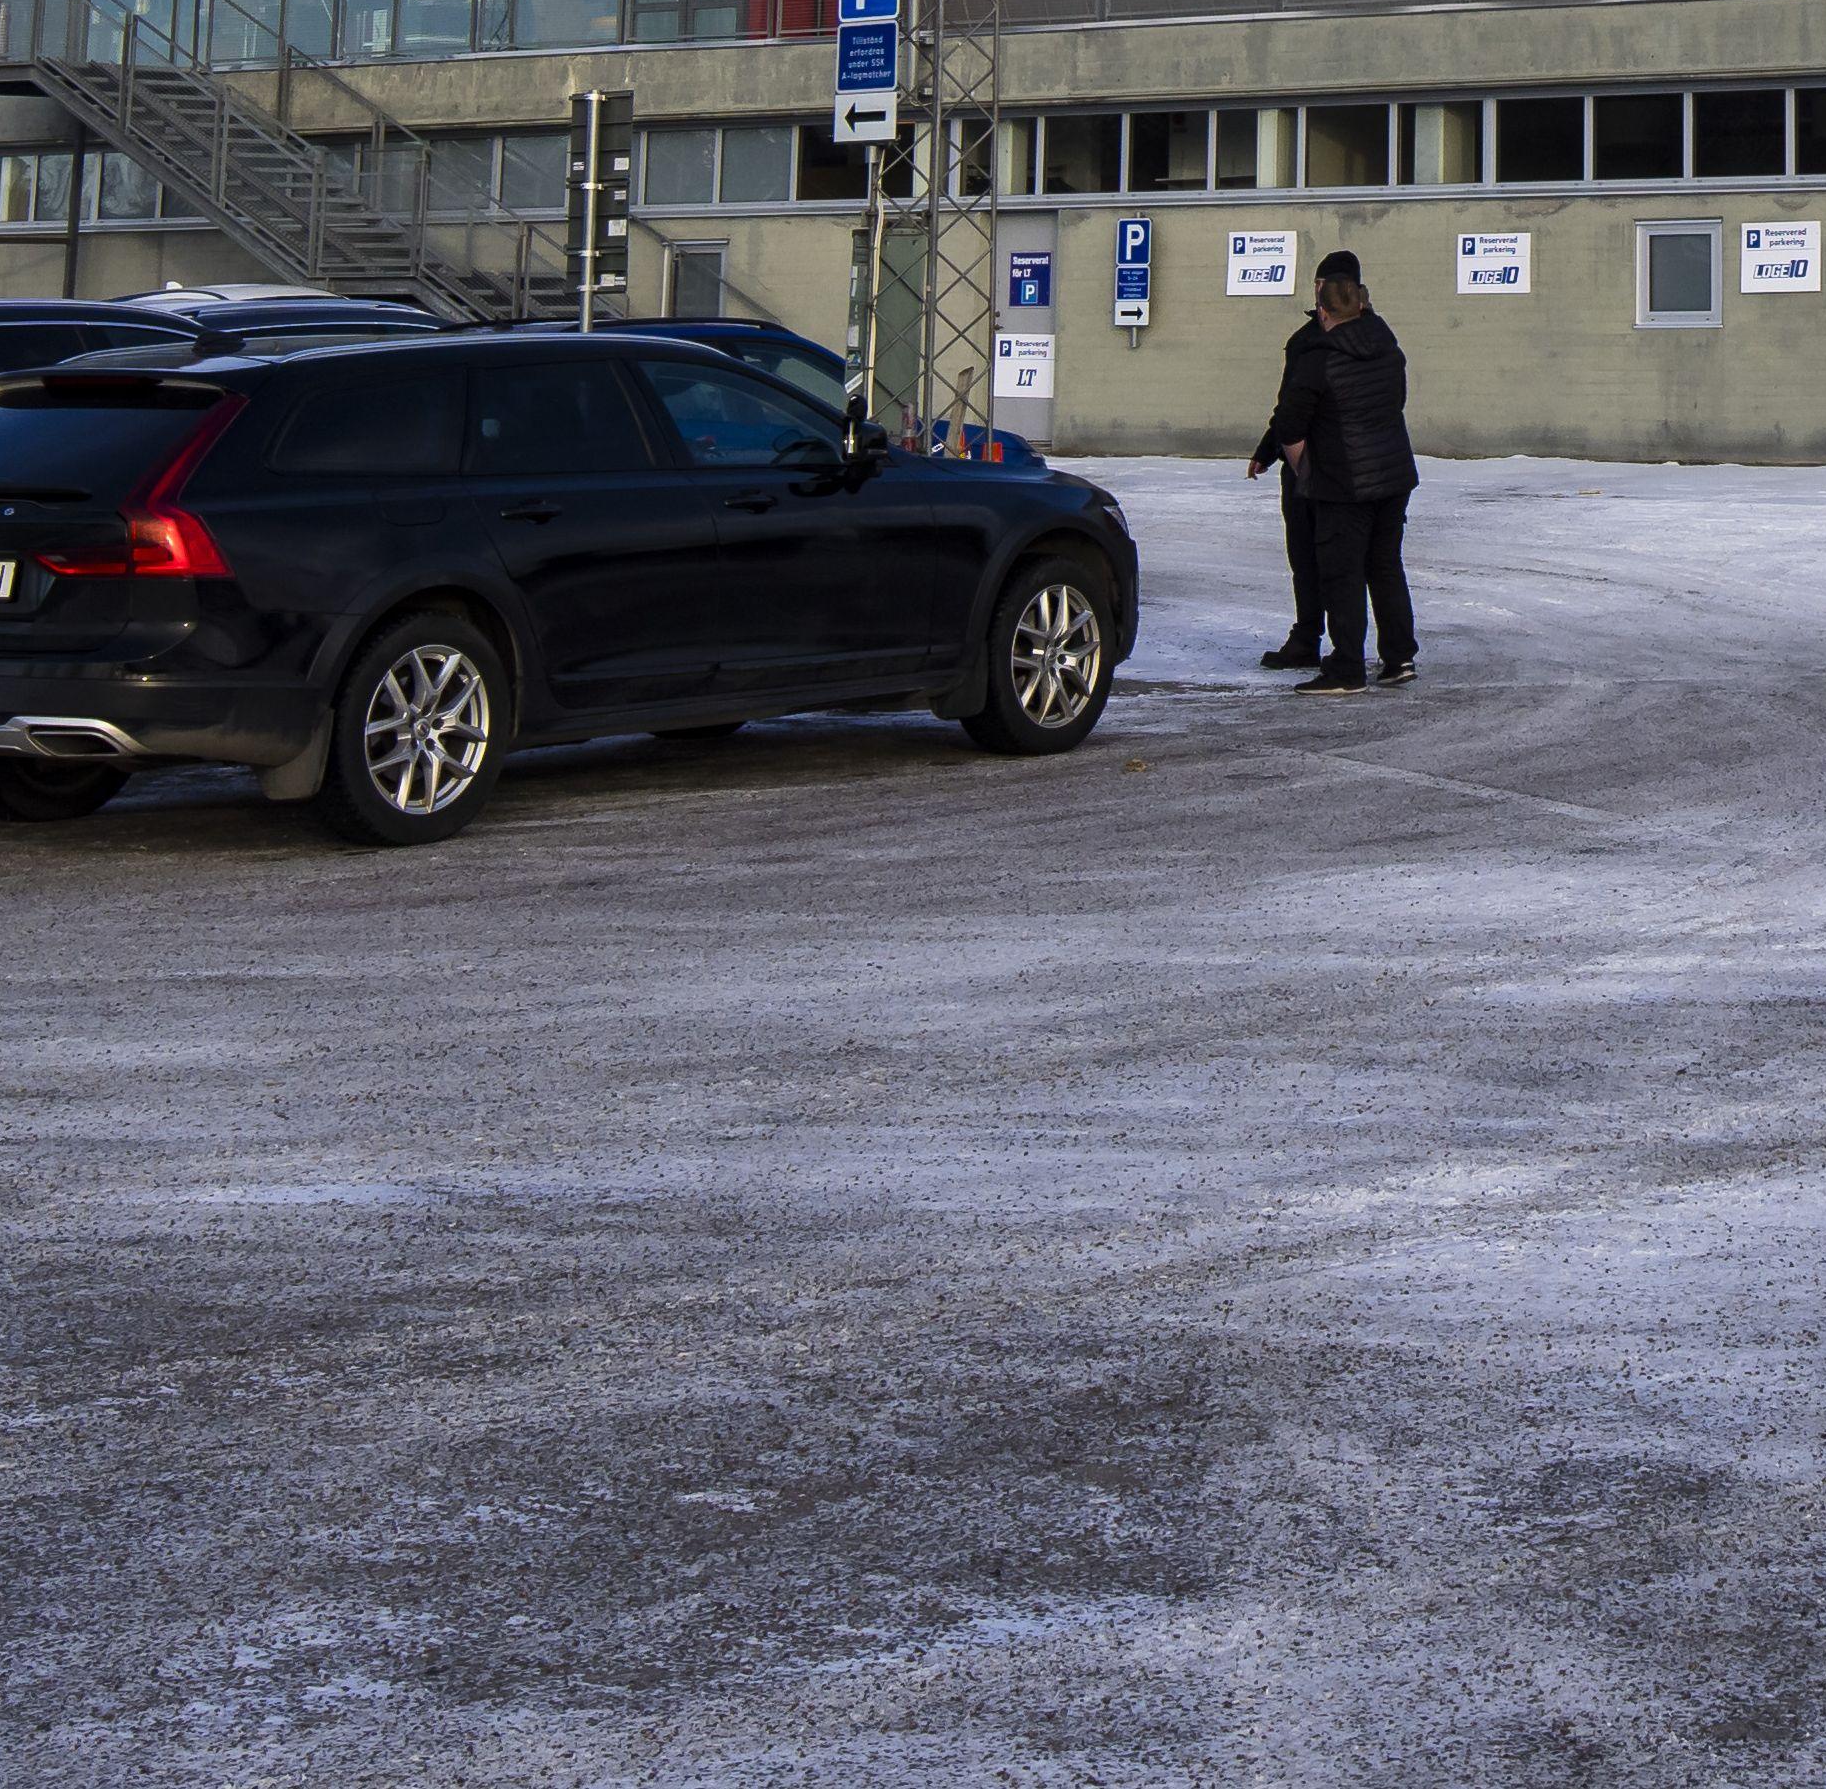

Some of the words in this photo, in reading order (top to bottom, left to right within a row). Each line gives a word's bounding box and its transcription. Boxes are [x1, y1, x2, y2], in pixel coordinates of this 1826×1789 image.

[1126, 224, 1145, 260] P
[1236, 240, 1243, 252] P
[1749, 233, 1758, 246] P
[1465, 240, 1473, 253] P
[1025, 284, 1036, 301] P
[1002, 343, 1009, 355] P
[1016, 368, 1037, 387] LT
